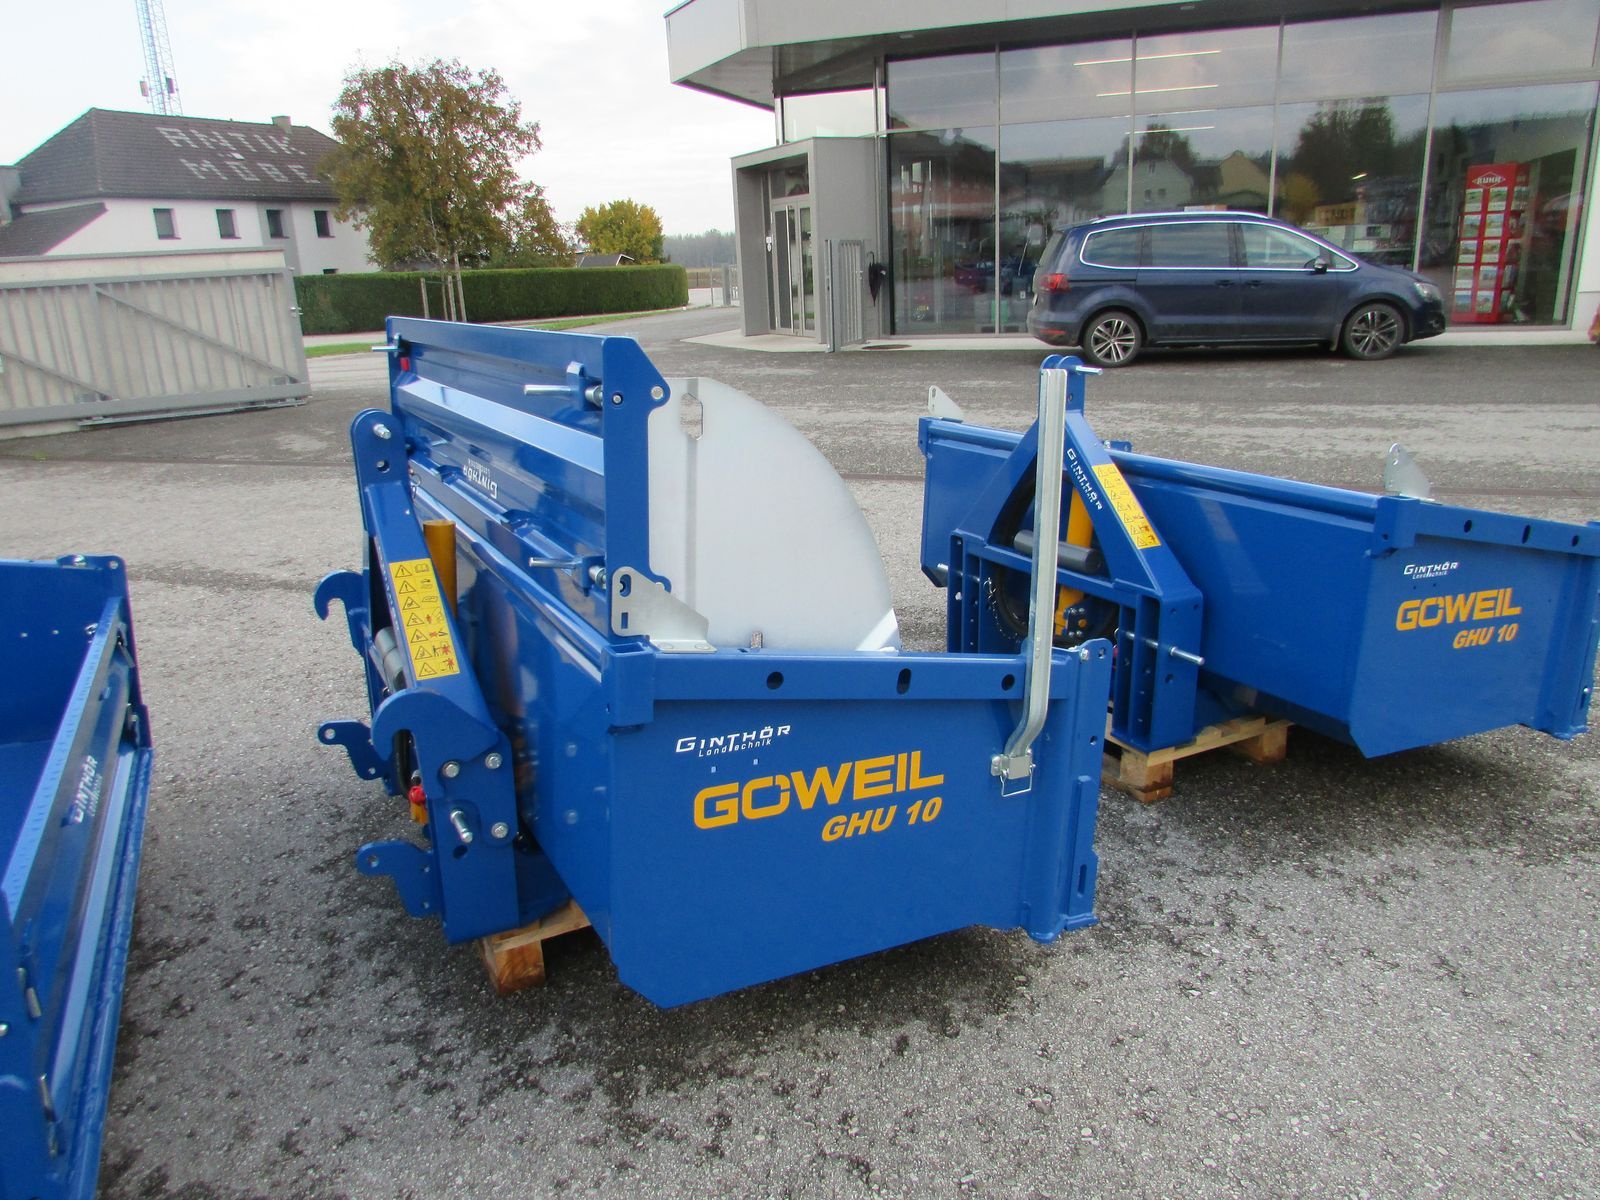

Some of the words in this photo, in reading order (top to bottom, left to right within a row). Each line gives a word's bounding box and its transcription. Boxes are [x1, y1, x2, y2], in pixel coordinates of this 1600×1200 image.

[155, 127, 307, 155] ANTIK
[179, 152, 333, 184] MÖBE
[1404, 561, 1459, 577] GINTHÖR
[1452, 626, 1495, 649] GHU
[1497, 623, 1519, 643] 10
[675, 725, 791, 752] GINTHÖR
[821, 805, 897, 842] GHU
[906, 797, 943, 825] 10
